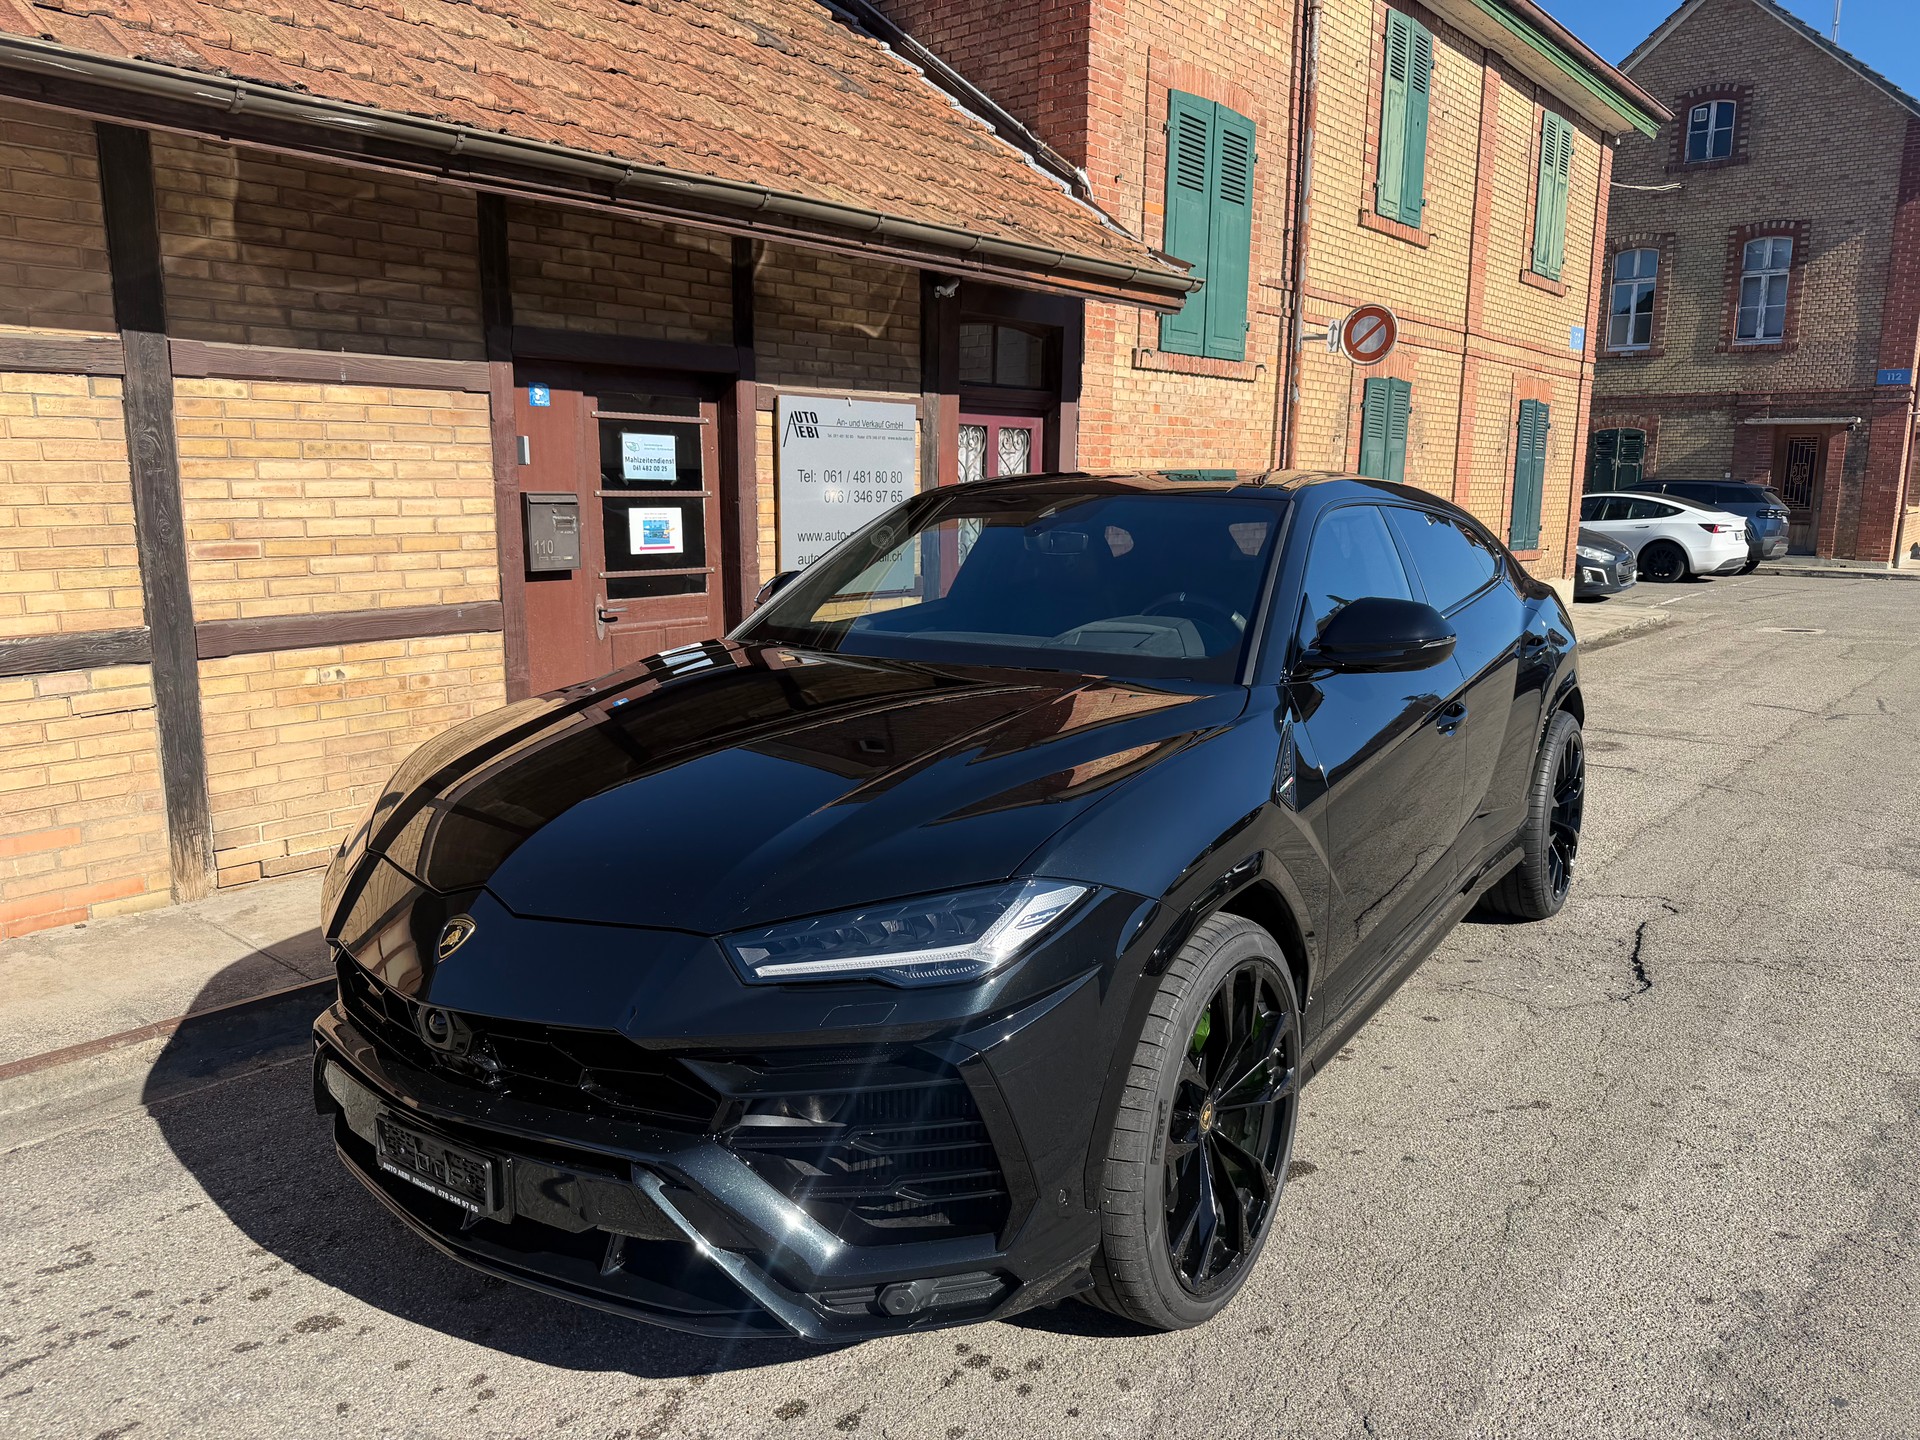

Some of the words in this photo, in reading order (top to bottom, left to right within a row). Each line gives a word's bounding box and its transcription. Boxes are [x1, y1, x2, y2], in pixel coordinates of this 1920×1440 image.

[1887, 373, 1902, 381] 112
[848, 419, 860, 427] und
[861, 419, 884, 429] Verkauf
[885, 421, 904, 430] GmbH
[624, 456, 675, 465] Mahlzeitendienst
[797, 469, 817, 483] Tel:
[823, 469, 842, 483] 061
[846, 470, 851, 483] /
[852, 470, 871, 484] 481
[875, 470, 888, 484] 80
[890, 470, 903, 484] 80
[824, 490, 844, 503] 076
[846, 490, 851, 503] /
[853, 490, 873, 503] 346
[875, 490, 888, 503] 97
[890, 490, 903, 503] 65
[534, 540, 554, 554] 110
[383, 1162, 397, 1174] AUTO
[397, 1170, 410, 1181] AEBI
[438, 1189, 449, 1200] 076
[449, 1194, 461, 1205] 346
[462, 1200, 470, 1209] 97
[470, 1204, 479, 1213] 65
